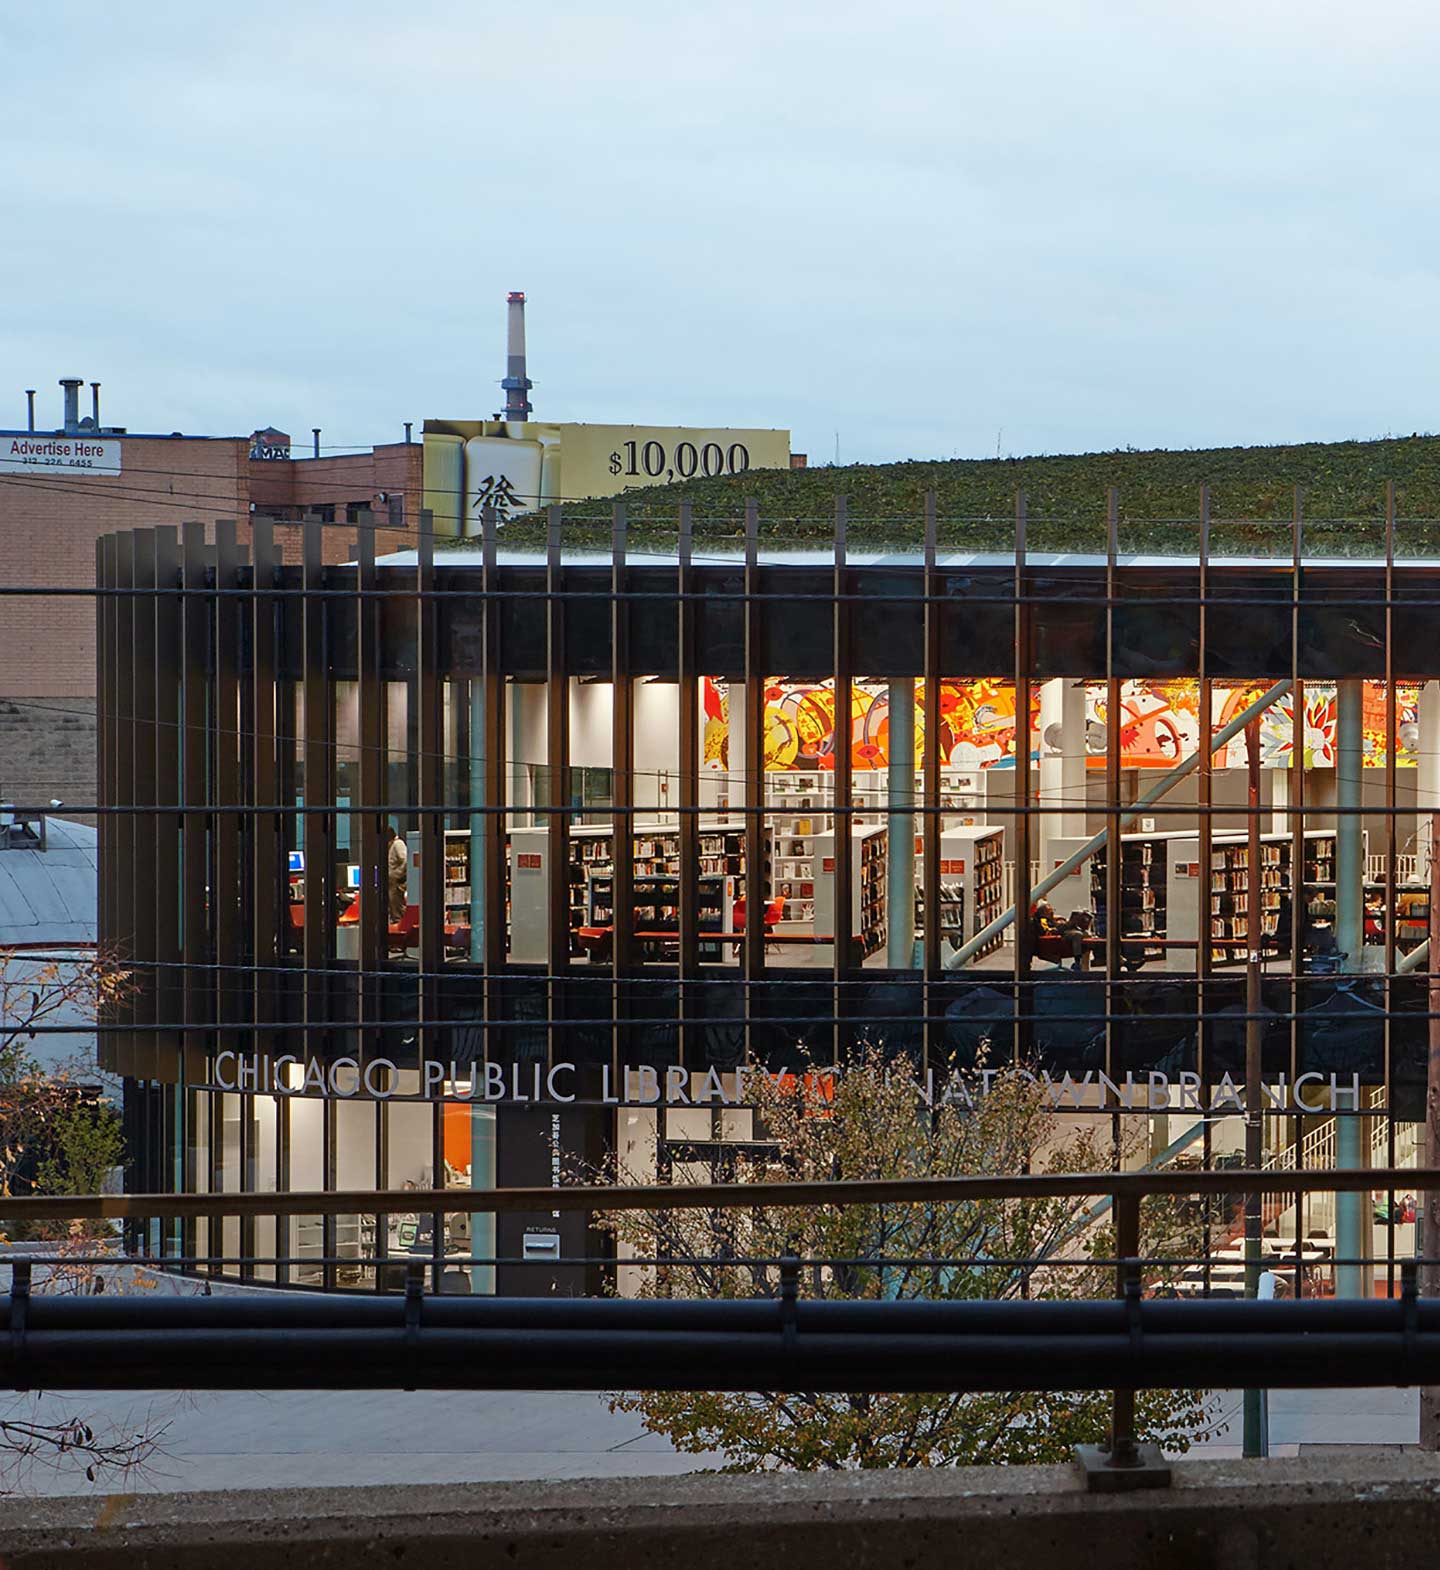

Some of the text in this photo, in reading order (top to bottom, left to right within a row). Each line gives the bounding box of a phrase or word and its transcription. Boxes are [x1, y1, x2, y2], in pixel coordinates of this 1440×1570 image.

[10, 440, 104, 457] Advertise Here
[609, 440, 750, 484] $10,000
[215, 1050, 400, 1098] CHICAGO
[424, 1060, 576, 1103] PUBLIC
[813, 1066, 1133, 1110] NATWN
[1149, 1070, 1360, 1113] BRANCH
